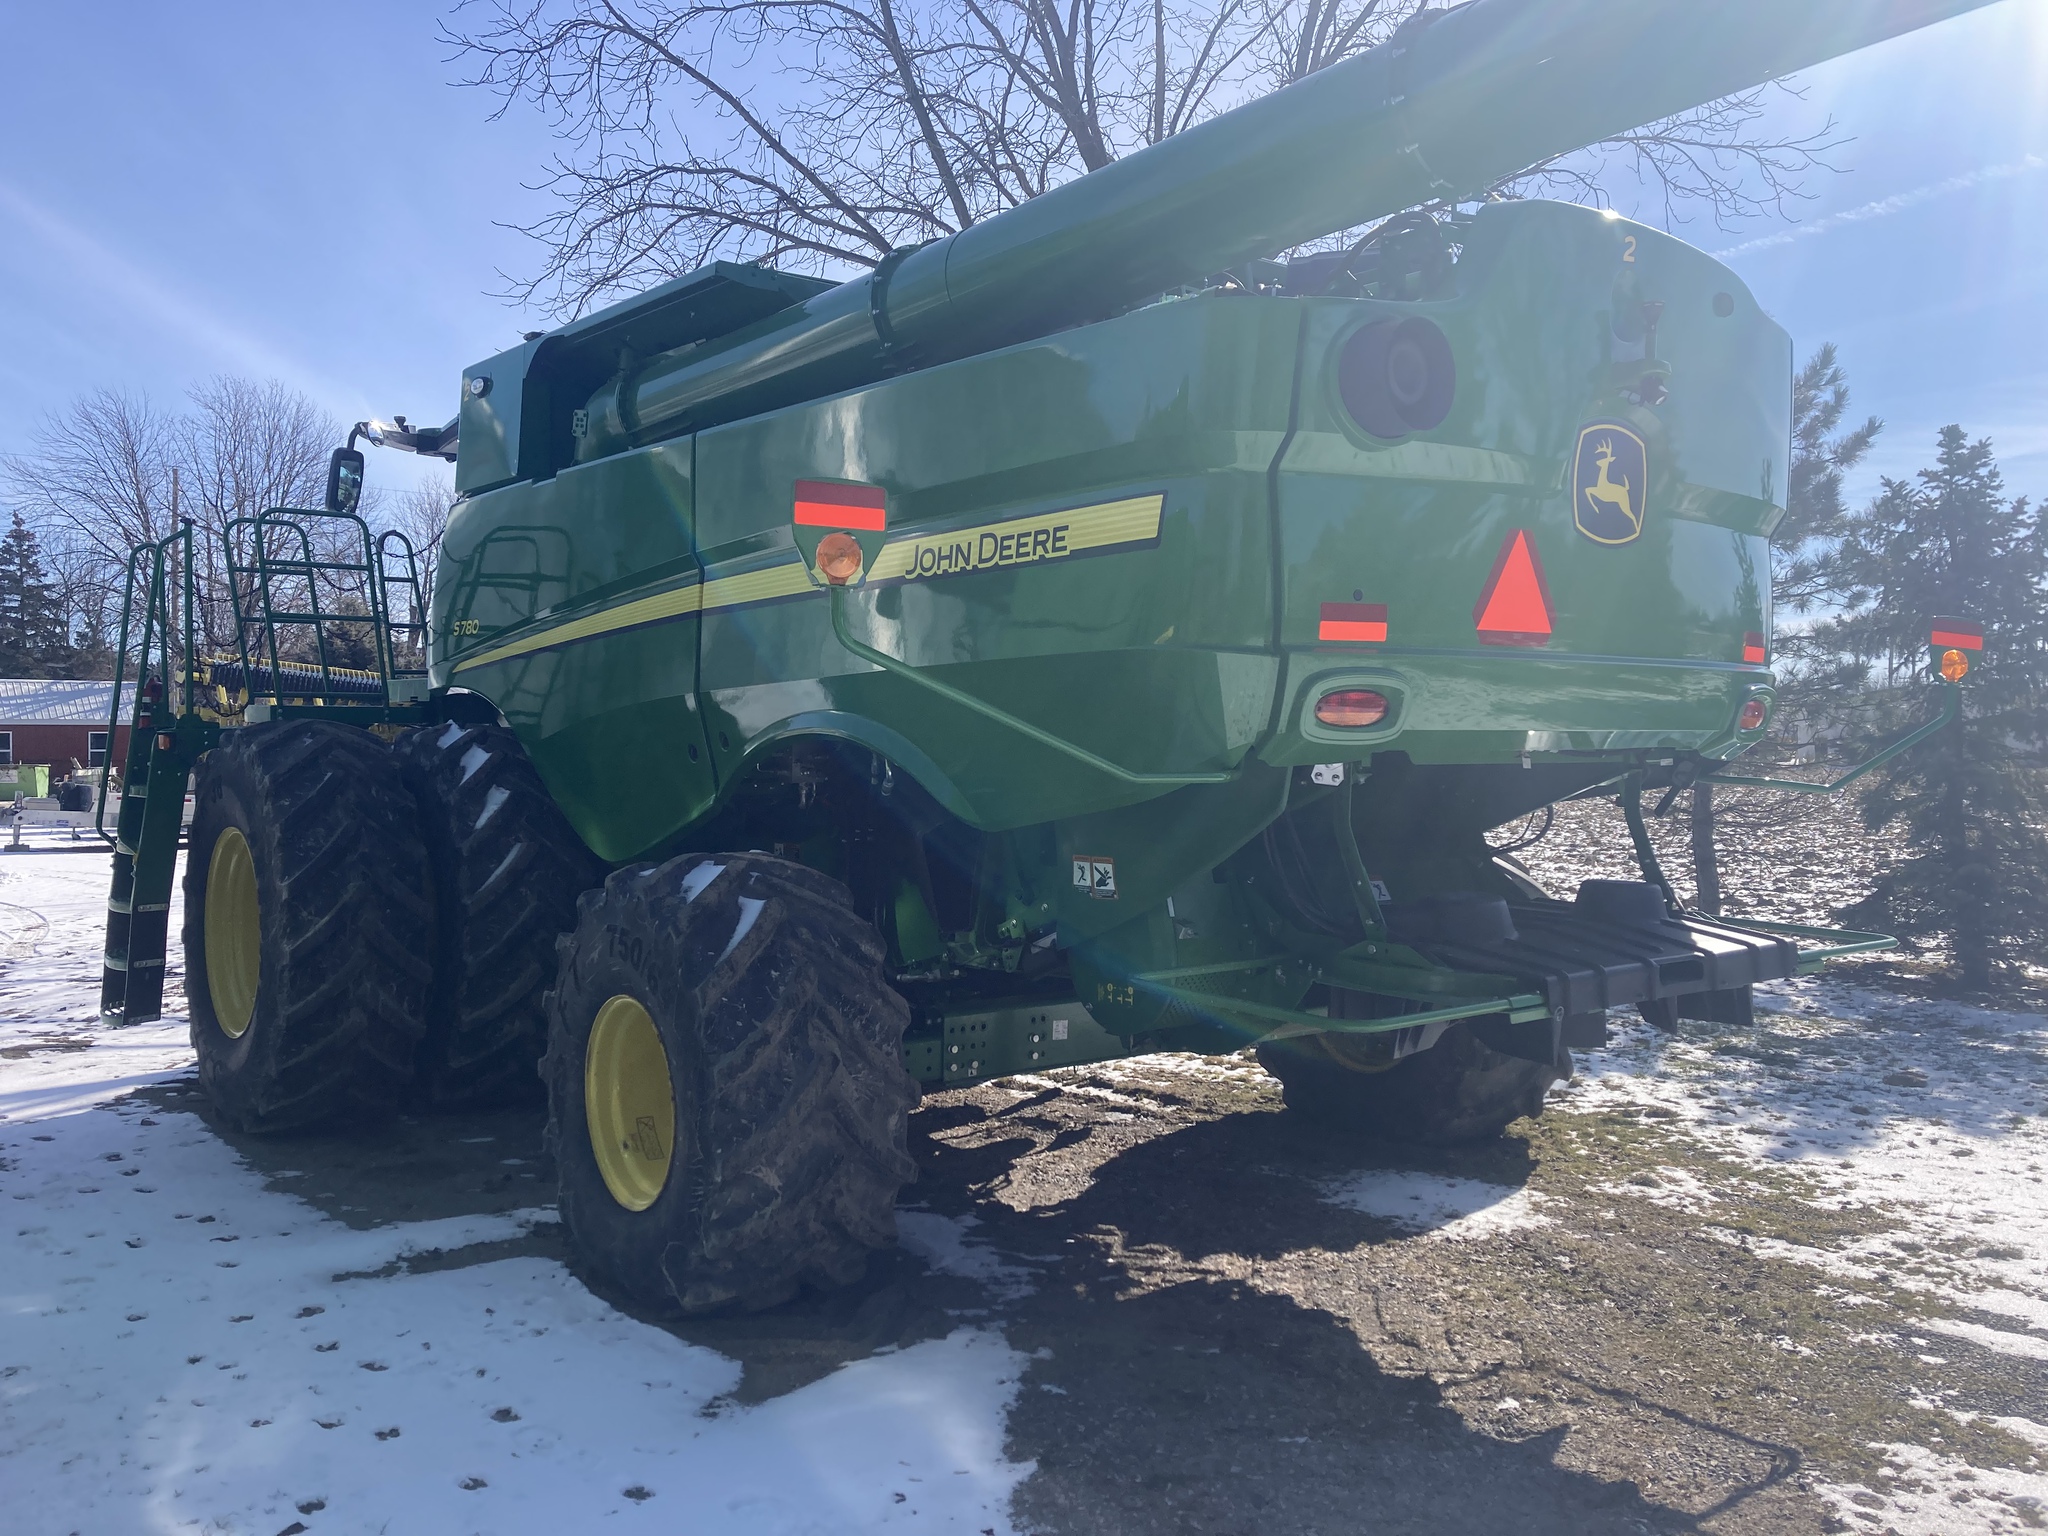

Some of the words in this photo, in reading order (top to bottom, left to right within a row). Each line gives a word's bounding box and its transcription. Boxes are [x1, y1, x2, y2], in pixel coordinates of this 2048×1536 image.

[1623, 235, 1636, 263] 2
[905, 541, 972, 577] JOHN
[977, 524, 1070, 565] DEERE
[453, 619, 480, 636] S780
